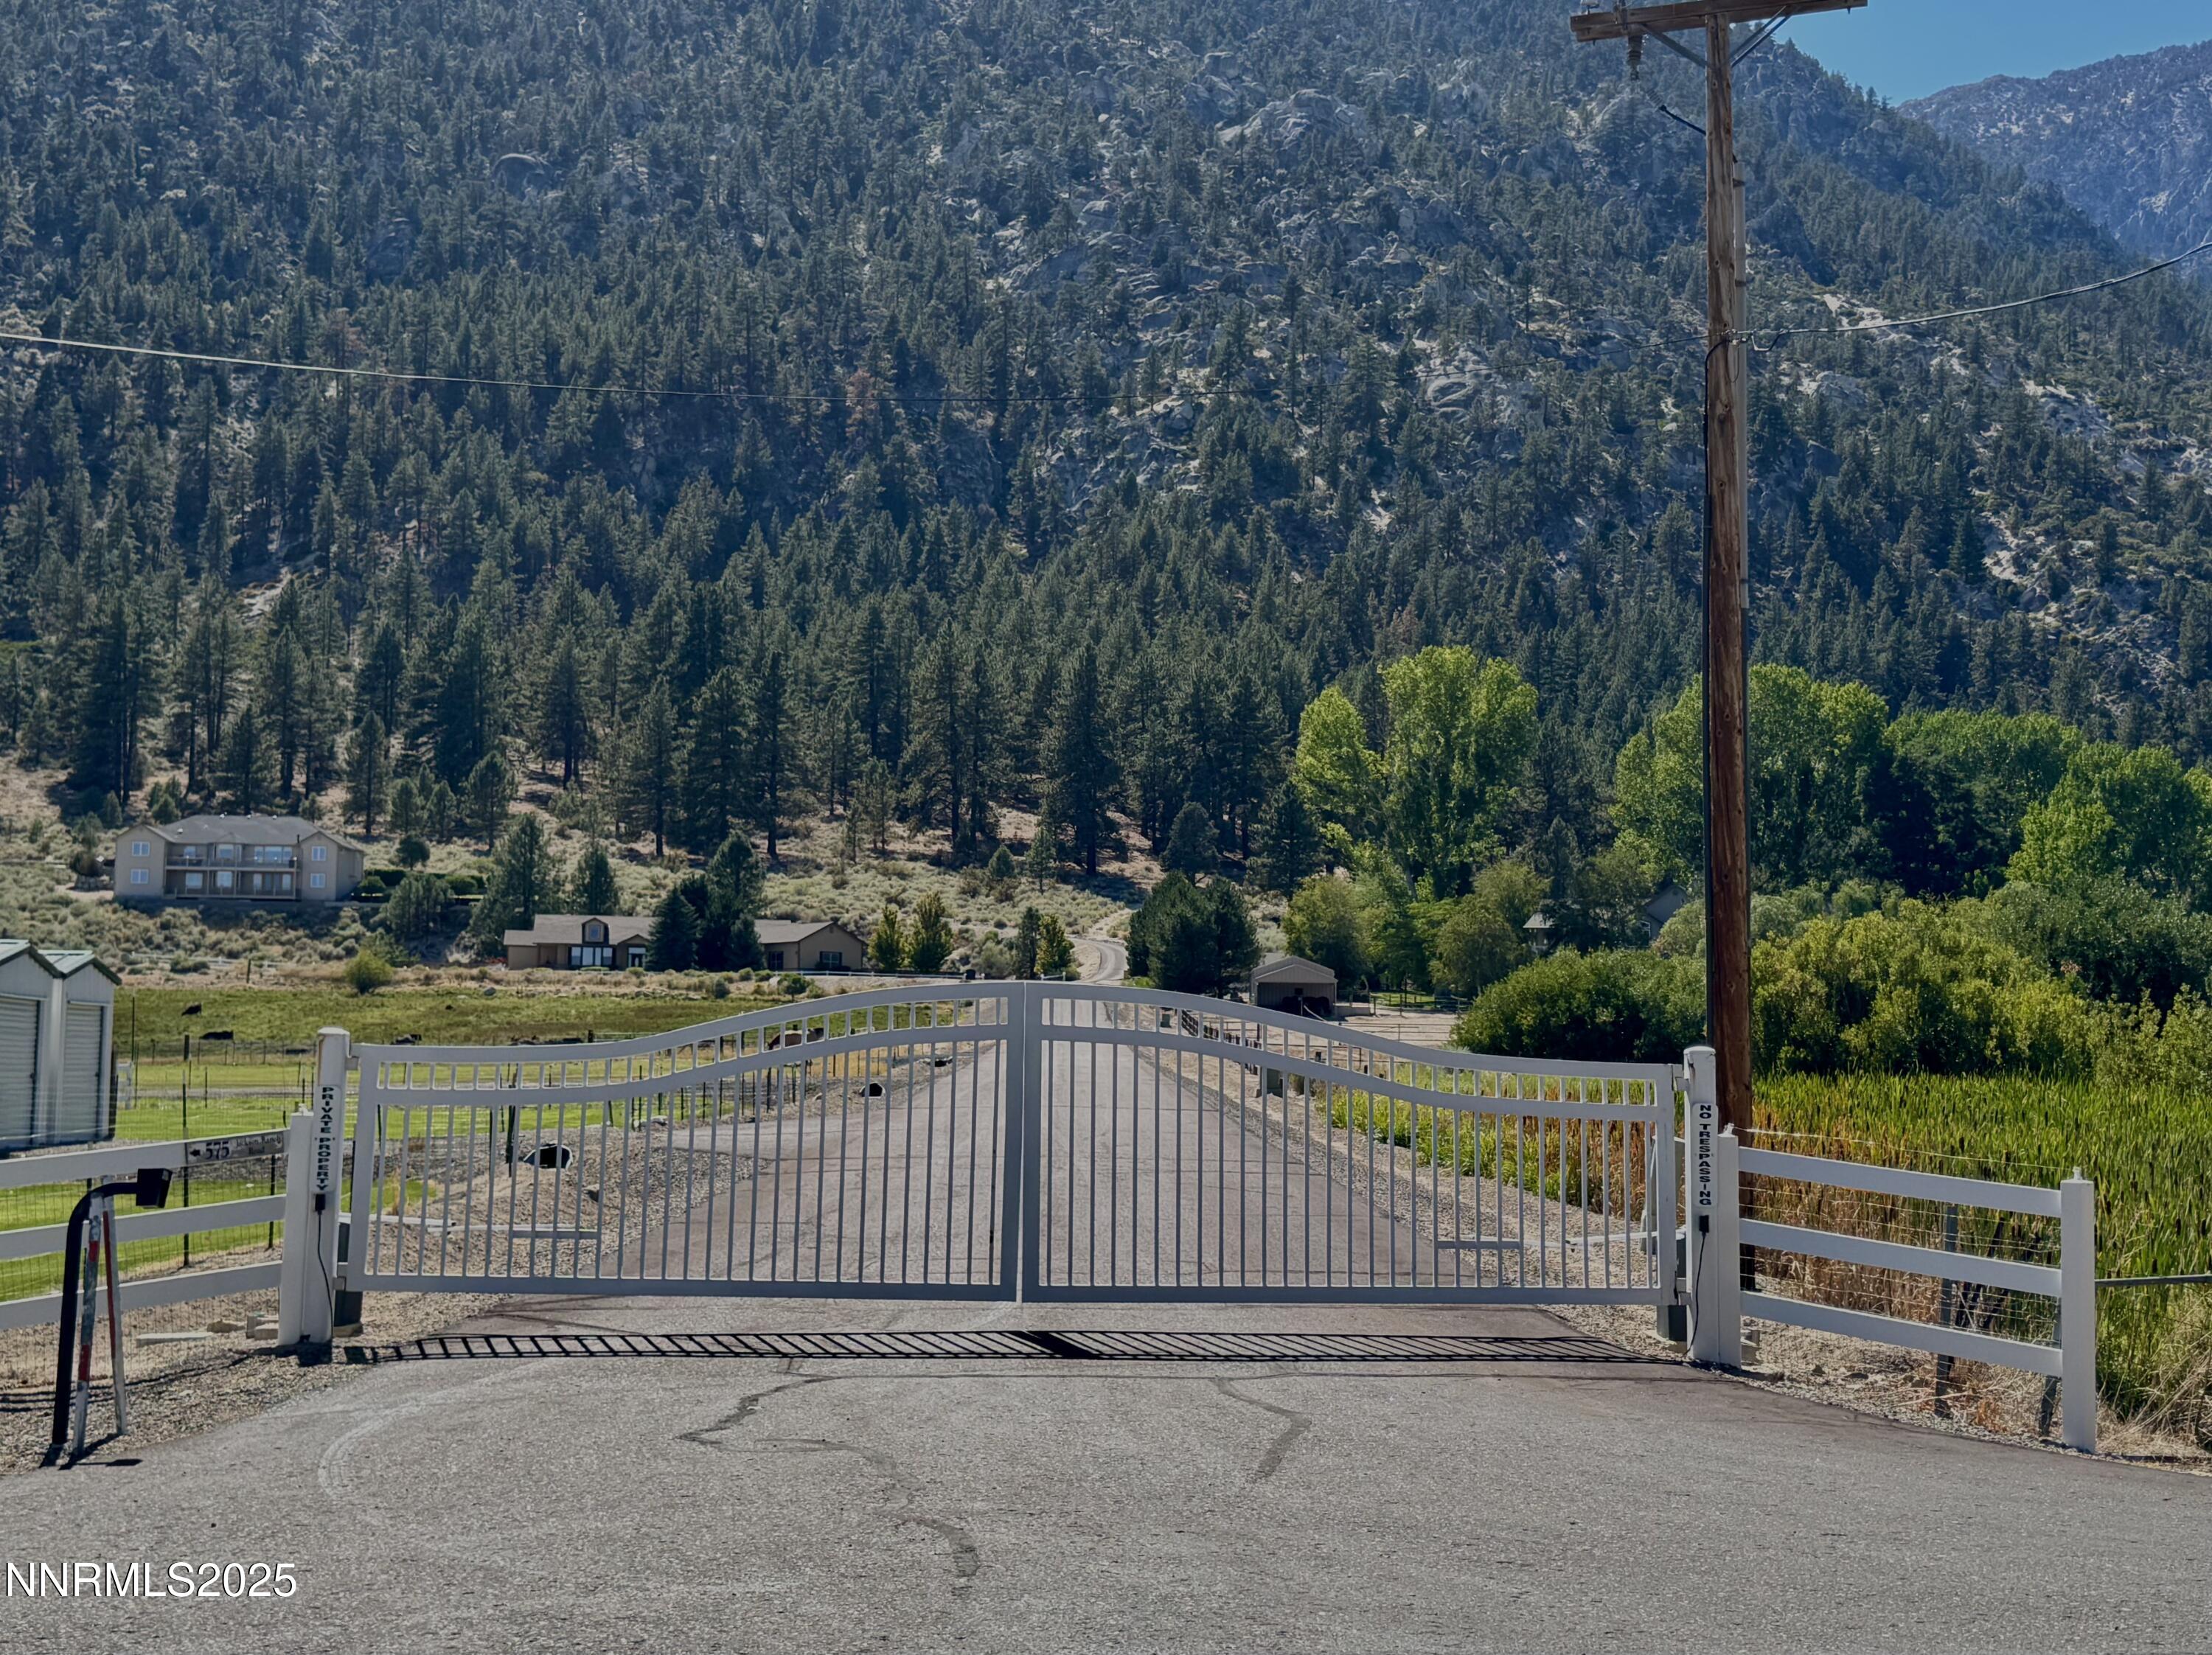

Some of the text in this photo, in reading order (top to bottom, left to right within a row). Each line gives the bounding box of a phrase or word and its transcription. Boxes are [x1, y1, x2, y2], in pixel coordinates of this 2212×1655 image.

[206, 1140, 230, 1160] 575
[316, 1087, 335, 1191] PRIVATE PROPERTY
[1698, 1104, 1712, 1205] NO TRESPASSING
